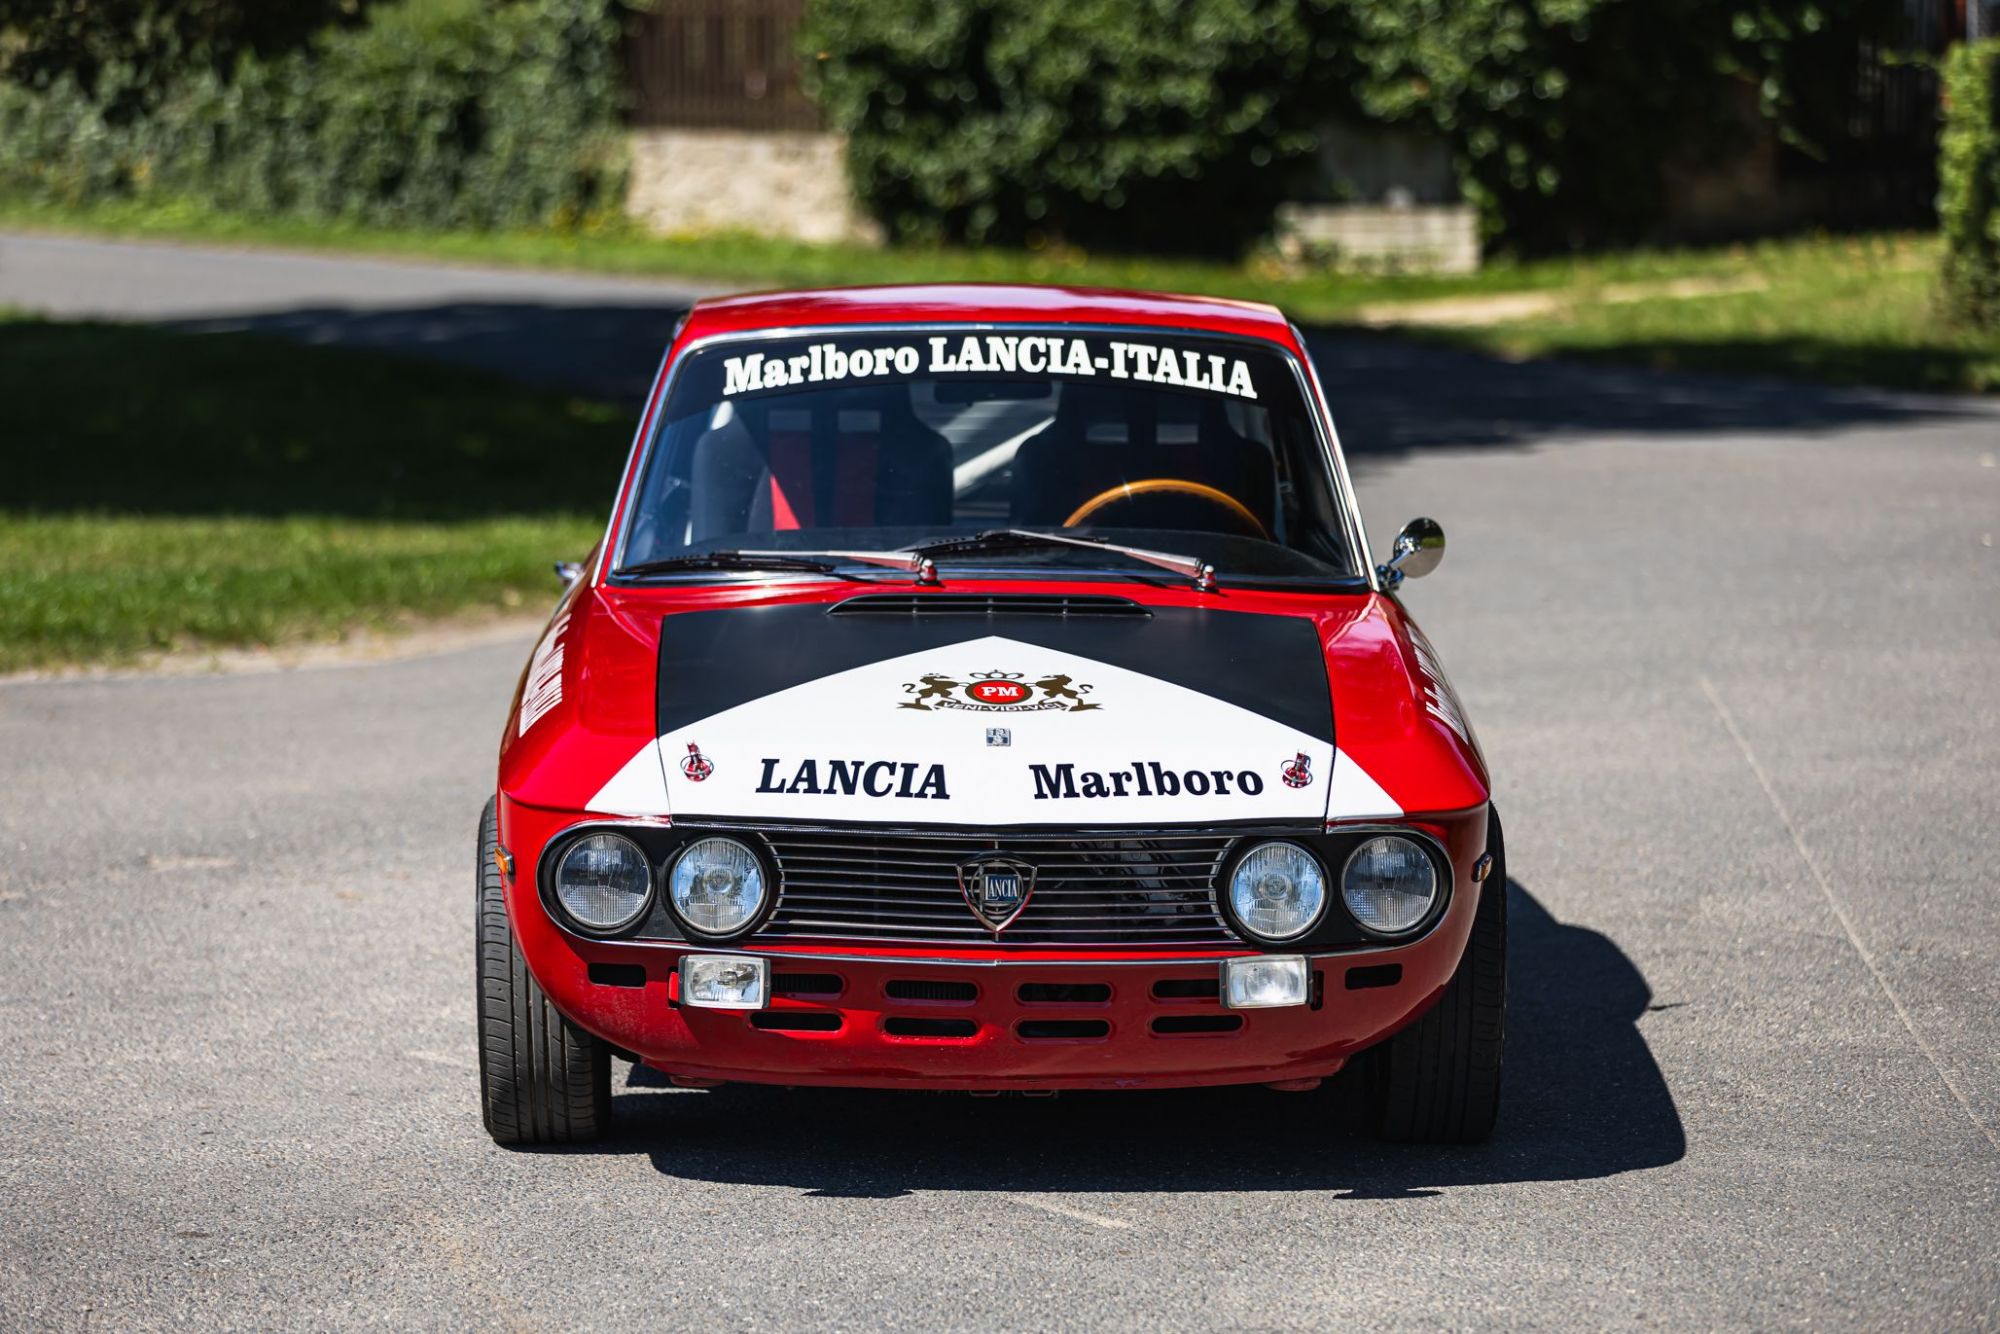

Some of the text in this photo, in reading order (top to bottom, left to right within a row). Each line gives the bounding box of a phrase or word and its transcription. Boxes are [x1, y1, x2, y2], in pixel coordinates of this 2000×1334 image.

[723, 336, 1258, 399] Marlboro LANCIA-ITALIA
[981, 686, 1019, 697] PM
[756, 758, 951, 800] LANCIA
[1029, 761, 1264, 800] Marlboro
[985, 875, 1018, 900] LANCIA
